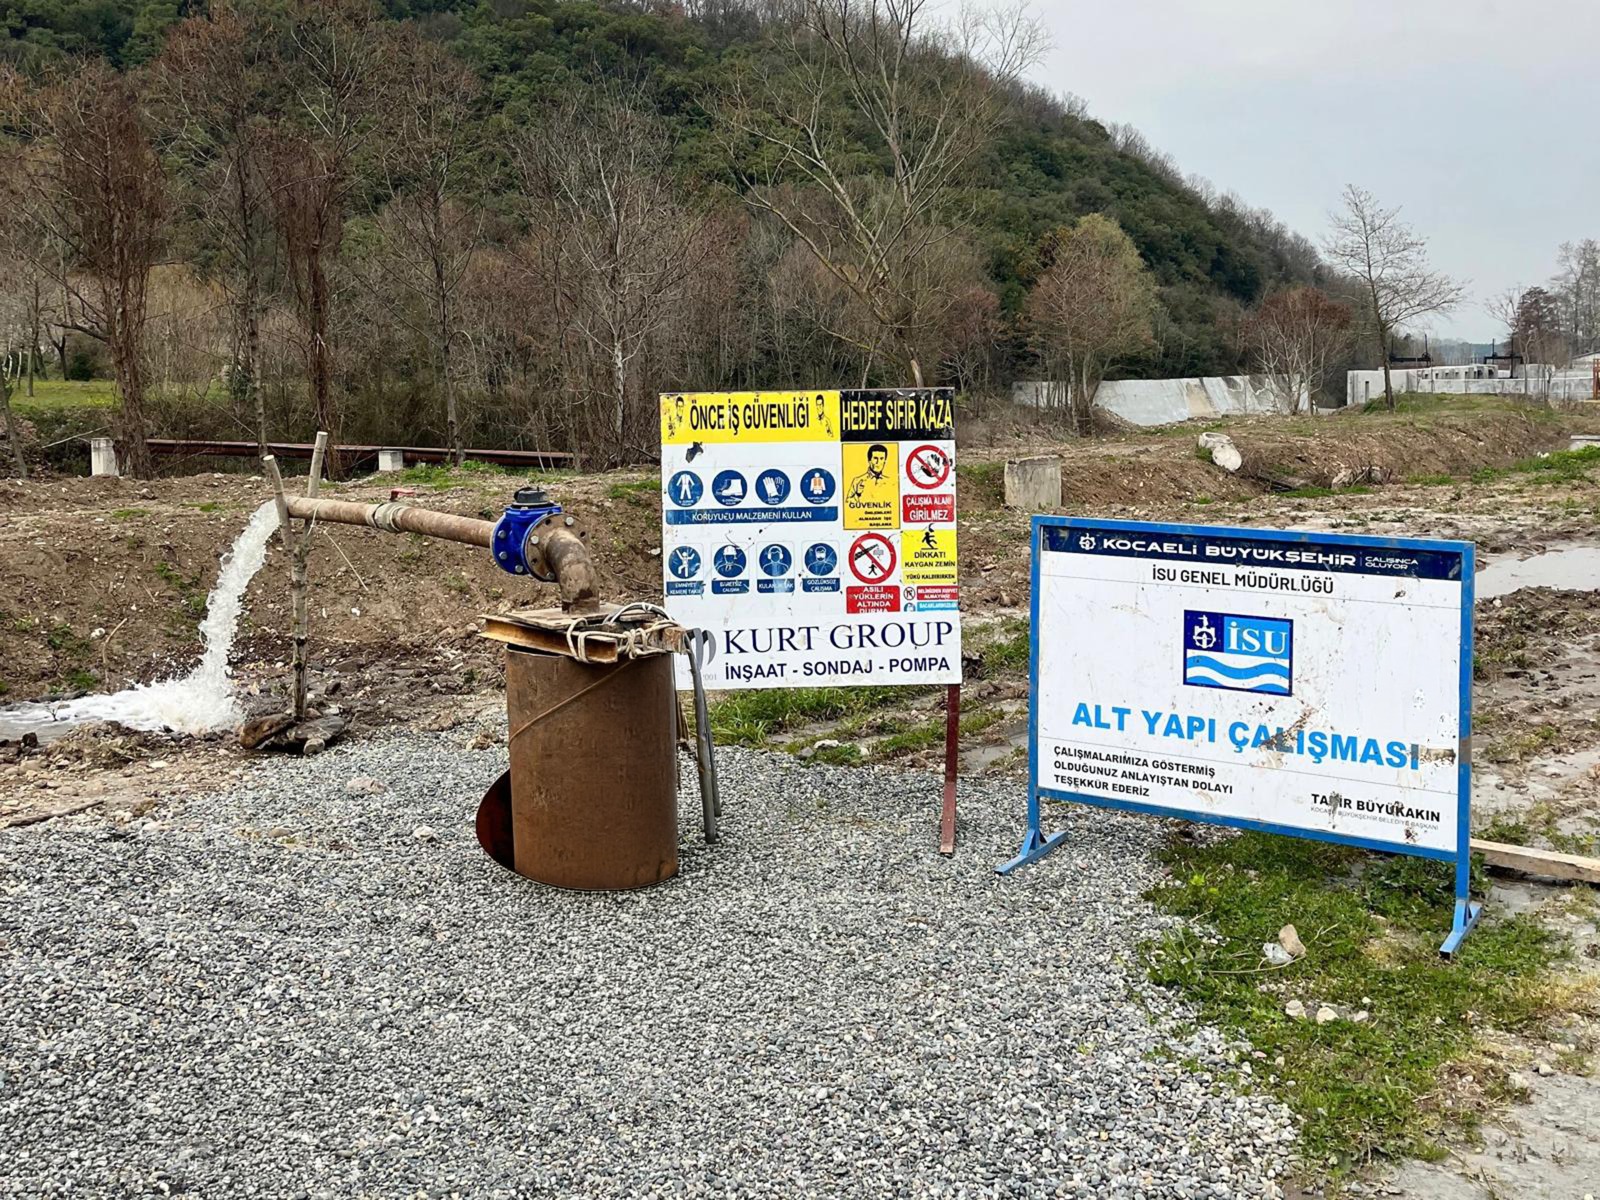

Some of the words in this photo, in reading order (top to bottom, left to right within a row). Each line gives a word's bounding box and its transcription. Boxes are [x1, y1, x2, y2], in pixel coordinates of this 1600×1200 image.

[690, 399, 725, 430] ÖNCE
[728, 398, 739, 435] İŞ
[743, 397, 809, 429] GÜVENLİĞİ
[842, 400, 882, 430] HEDEF
[886, 400, 917, 430] SIFIR
[920, 399, 953, 430] KAZA
[736, 511, 780, 520] MALZEMENİ
[782, 511, 812, 519] KULLAN
[849, 501, 892, 509] GÜVENLİK
[906, 495, 933, 507] ÇALIŞMA
[910, 508, 948, 521] GİRİLMEZ
[914, 551, 946, 559] DİKKAT!
[1365, 562, 1408, 570] OLUYOR
[1153, 564, 1176, 581] İSU
[1180, 569, 1231, 586] GENEL
[1235, 571, 1333, 594] MÜDÜRLÜĞÜ
[723, 626, 819, 655] KURT
[829, 621, 953, 649] GROUP
[1228, 621, 1288, 655] İSU
[725, 662, 787, 683] İNŞAAT
[803, 658, 873, 676] SONDAJ
[889, 656, 950, 673] POMPA
[1072, 702, 1131, 731] ALT
[1141, 710, 1216, 743] YAPI
[1228, 721, 1419, 771] ÇALIŞMASI
[1054, 746, 1149, 767] ÇALIŞMALARIMIZA
[1152, 760, 1215, 779] GÖSTERMİŞ
[1054, 760, 1118, 778] OLDUĞUNUZ
[1121, 770, 1189, 788] ANLAYIŞTAN
[1192, 780, 1233, 794] DOLAYI
[1054, 774, 1109, 791] TEŞEKKÜR
[1112, 782, 1150, 797] EDERİZ
[1311, 793, 1352, 809] TAİR
[1357, 799, 1440, 822] BÜYÜKAKIN
